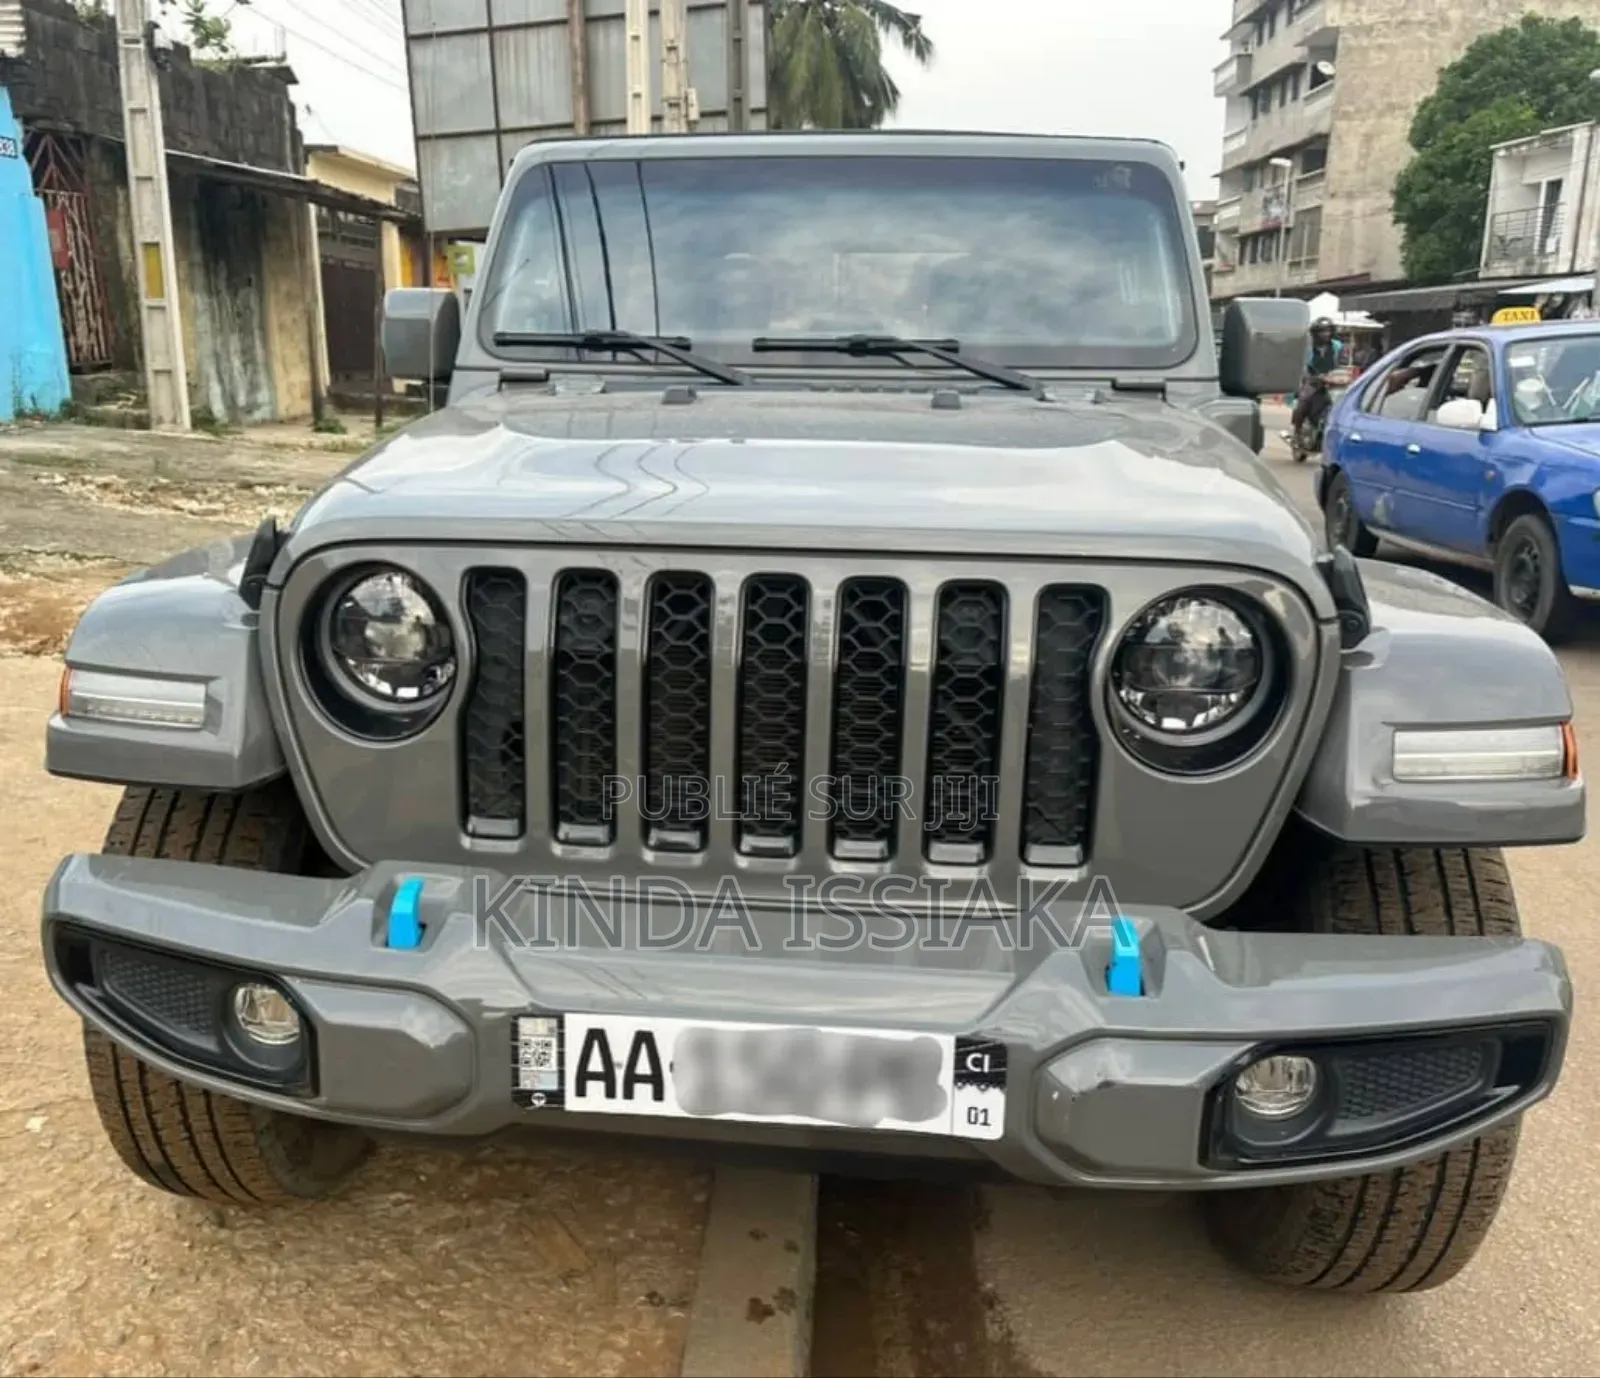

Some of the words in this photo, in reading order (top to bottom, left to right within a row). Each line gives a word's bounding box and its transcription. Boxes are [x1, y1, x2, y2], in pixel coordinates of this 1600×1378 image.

[1502, 310, 1536, 321] TAXI
[966, 1052, 990, 1073] CI
[967, 1106, 992, 1126] 01
